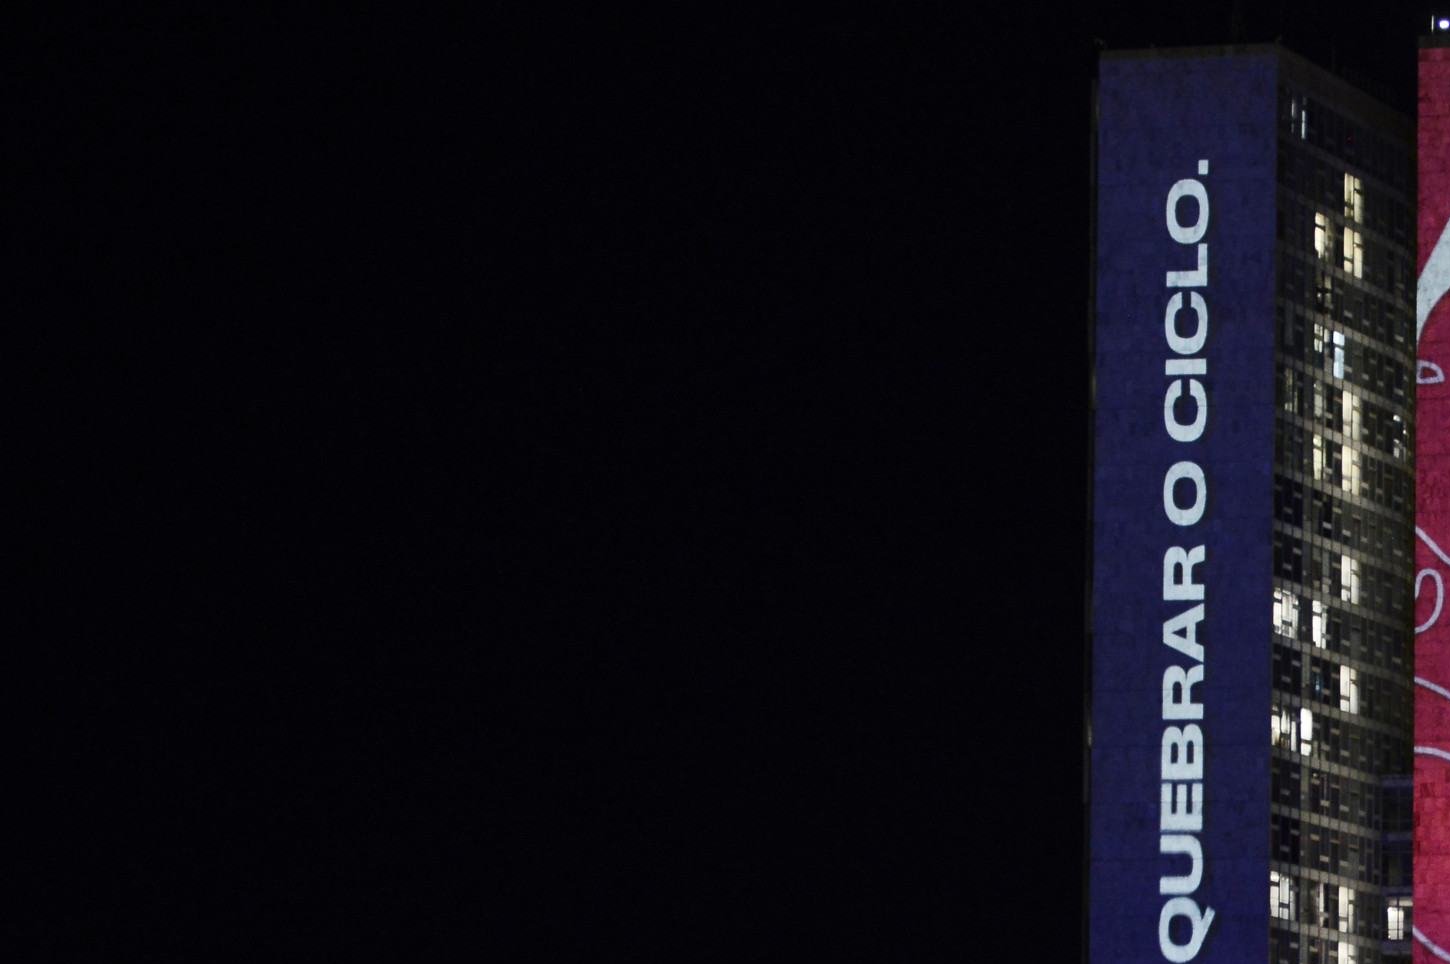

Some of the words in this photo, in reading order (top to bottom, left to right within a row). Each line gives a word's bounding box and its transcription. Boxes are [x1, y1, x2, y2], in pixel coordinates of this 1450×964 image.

[1164, 159, 1209, 441] CICLO.
[1164, 461, 1207, 527] O
[1159, 545, 1215, 964] QUEBRAR
